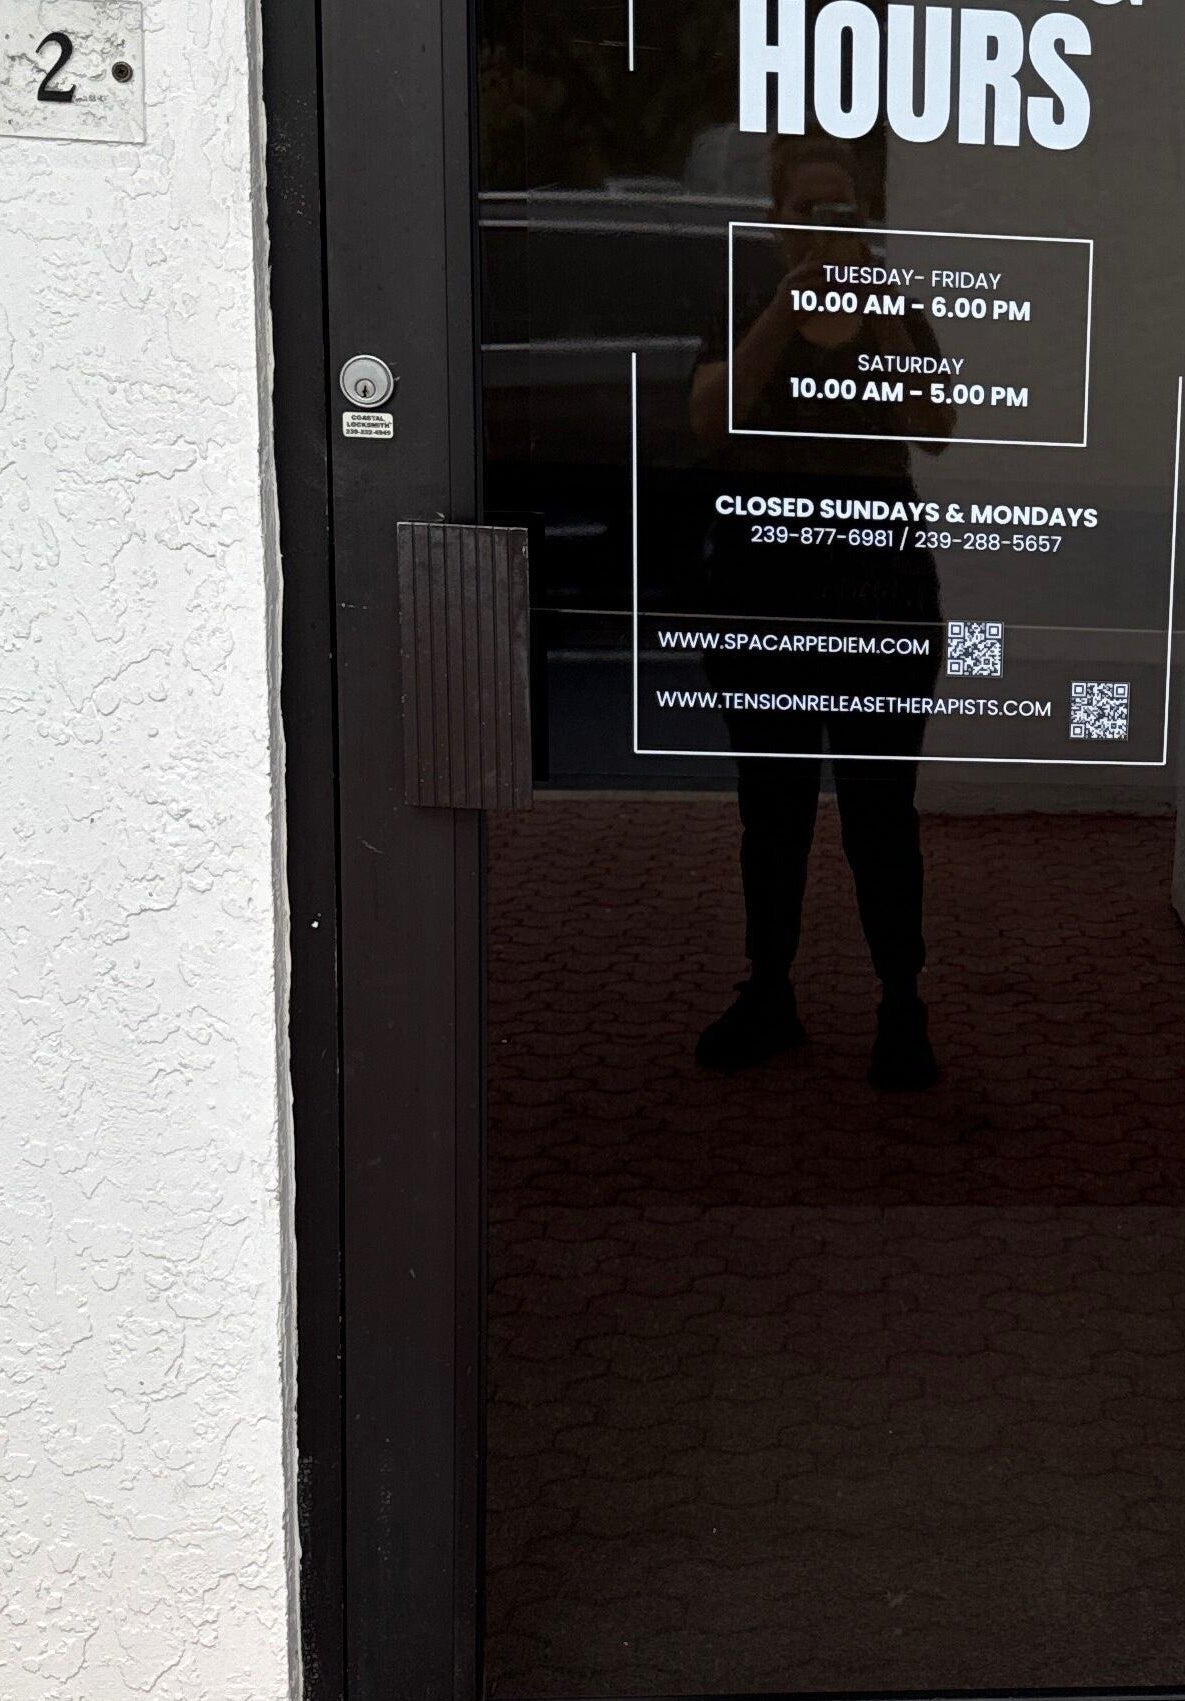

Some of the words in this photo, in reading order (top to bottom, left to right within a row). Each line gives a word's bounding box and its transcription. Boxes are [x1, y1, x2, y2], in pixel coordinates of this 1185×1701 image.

[36, 32, 76, 103] 2
[739, 0, 1093, 151] HOURS
[822, 264, 925, 286] TUESDAY-
[931, 269, 1002, 290] FRIDAY
[790, 289, 858, 313] 10.00
[862, 294, 906, 316] AM
[931, 296, 987, 319] 6.00
[992, 299, 1031, 322] PM
[857, 353, 965, 375] SATURDAY
[789, 376, 857, 400] 10.00
[861, 380, 904, 402] AM
[930, 382, 985, 405] 5.00
[990, 386, 1029, 408] PM
[715, 494, 815, 518] CLOSED
[819, 498, 940, 523] SUNDAYS
[945, 503, 966, 524] &
[970, 504, 1099, 528] MONDAYS
[751, 525, 893, 548] 239-877-6981
[914, 530, 1063, 553] 239-288-5657
[657, 630, 930, 656] WWW.SPACARPEDIEM.COM
[656, 690, 1052, 717] WWW.TENSIONRELEASETHERAPISTS.COM
